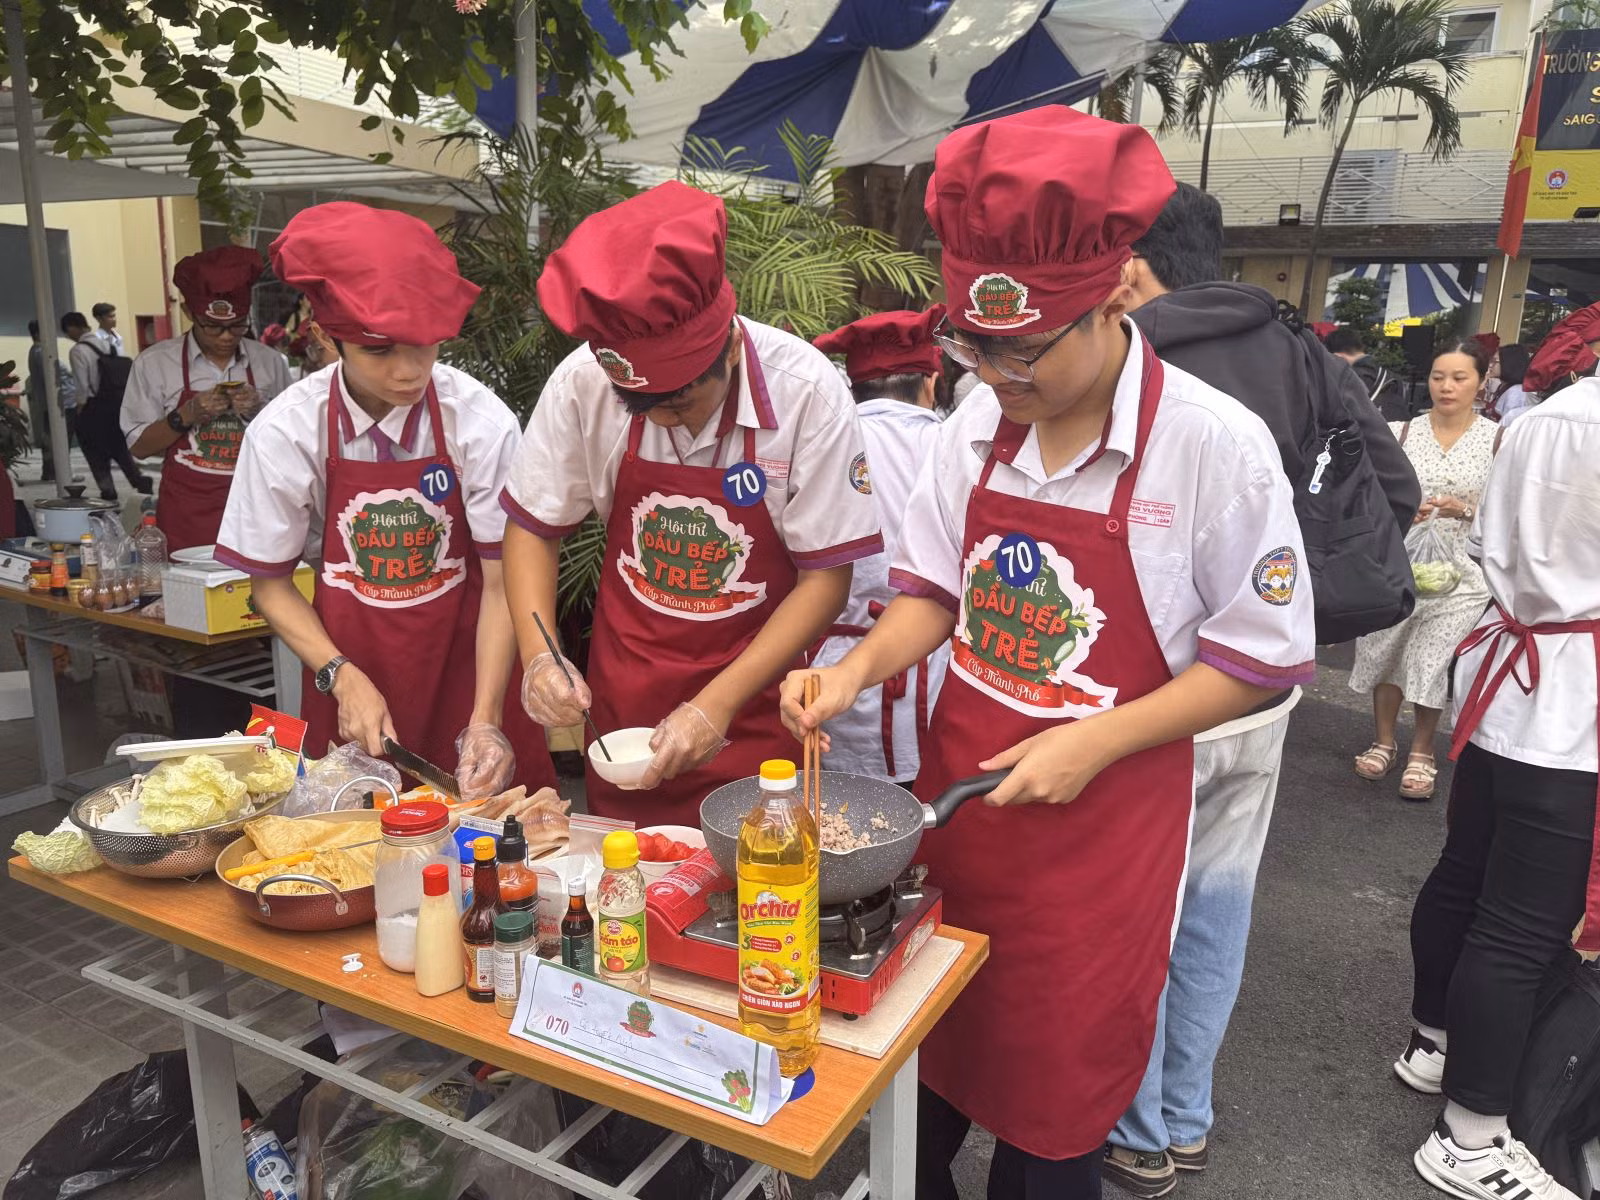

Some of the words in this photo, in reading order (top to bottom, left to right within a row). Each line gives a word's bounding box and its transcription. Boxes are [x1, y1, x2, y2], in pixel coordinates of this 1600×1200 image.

[423, 469, 449, 497] 70
[727, 468, 760, 500] 70
[372, 512, 400, 528] Hội
[660, 516, 687, 536] Hội
[356, 527, 397, 548] ĐẦU
[402, 523, 436, 547] BẾP
[644, 530, 681, 556] ĐẦU
[687, 540, 728, 563] BẾP
[369, 548, 427, 579] TRẺ
[1001, 541, 1034, 578] 70
[653, 558, 711, 591] TRẺ
[363, 585, 380, 597] Cấp
[380, 587, 414, 599] Thành
[643, 584, 659, 600] Cấp
[660, 593, 693, 610] Thành
[693, 599, 716, 613] Phố
[972, 583, 1016, 616] ĐẦU
[1020, 605, 1067, 636] BẾP
[980, 619, 1040, 671] TRẺ
[967, 657, 984, 677] Cấp
[984, 667, 1016, 693] Thành
[1016, 686, 1041, 702] Phố
[620, 935, 639, 946] táo
[741, 934, 752, 950] 3
[784, 1000, 801, 1008] NGON
[545, 1015, 569, 1036] 070
[1442, 1153, 1457, 1168] 33
